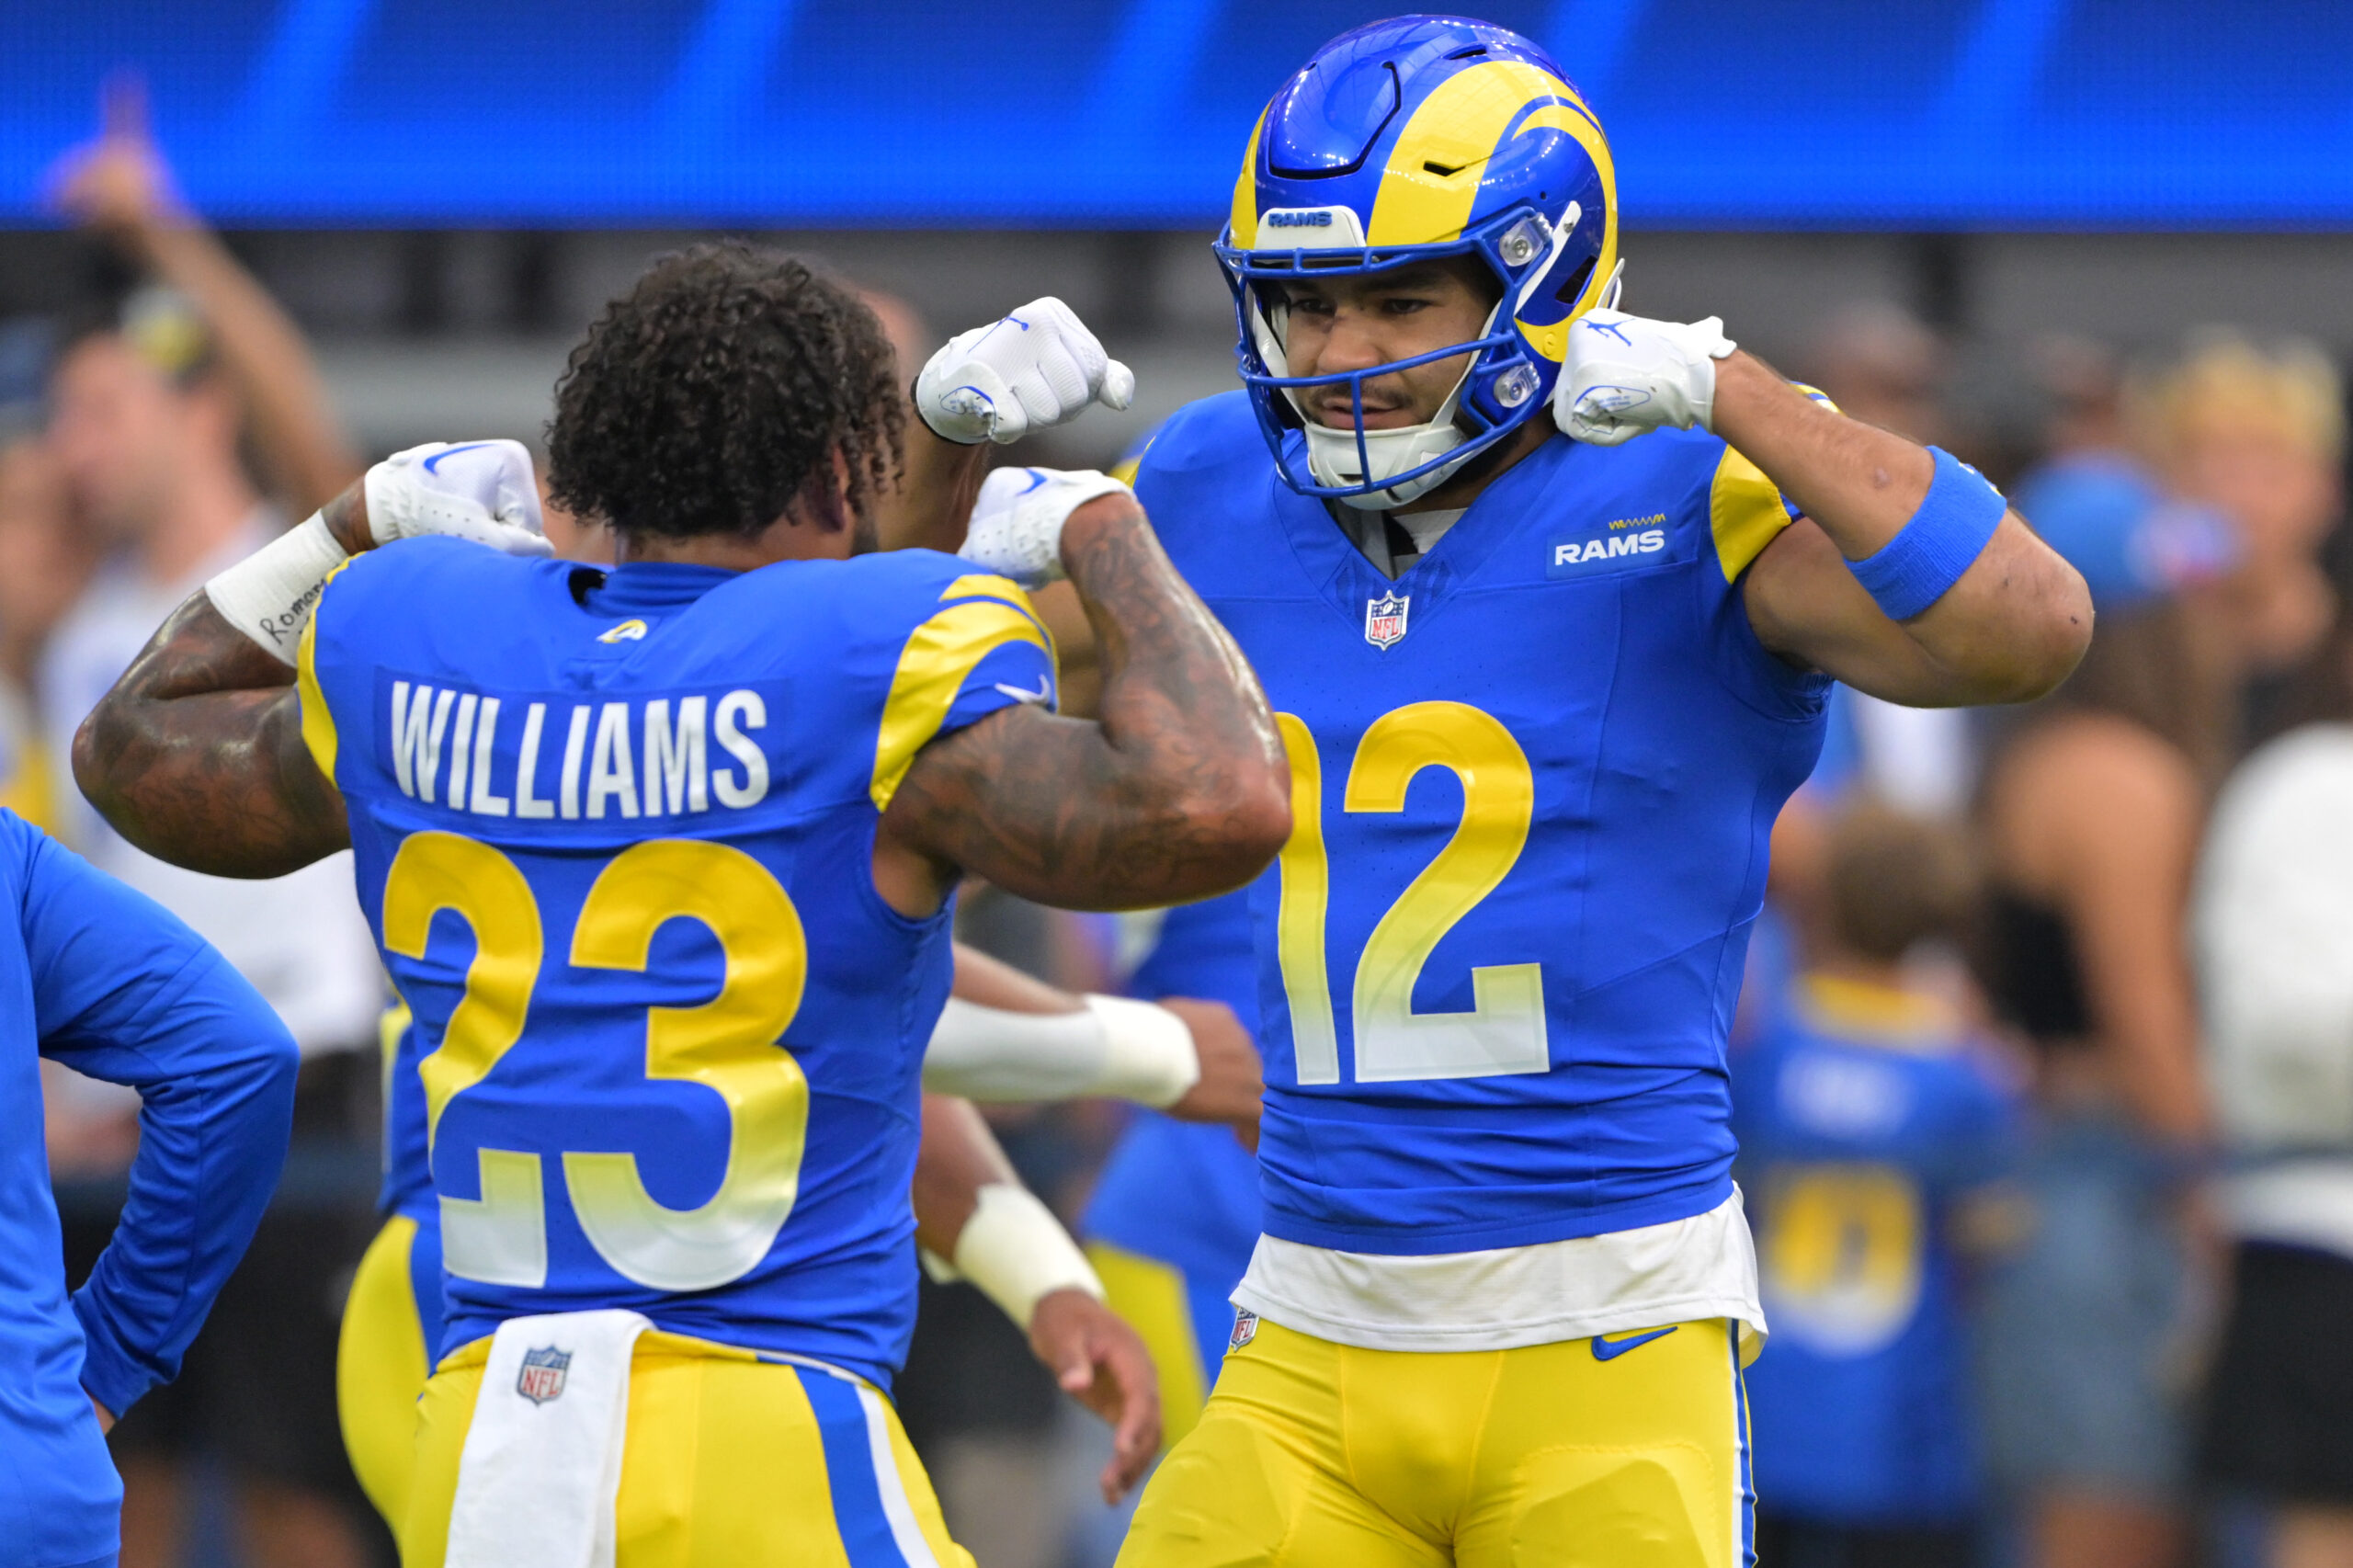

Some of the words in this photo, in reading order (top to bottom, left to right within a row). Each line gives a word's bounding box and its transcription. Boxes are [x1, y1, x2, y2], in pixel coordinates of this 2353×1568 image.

[1268, 211, 1332, 227] RAMS
[1554, 529, 1665, 566] RAMS
[1371, 617, 1399, 639] NFL
[392, 681, 769, 819] WILLIAMS
[1273, 700, 1551, 1085] 12
[382, 830, 810, 1291] 23
[522, 1369, 560, 1397] NFL
